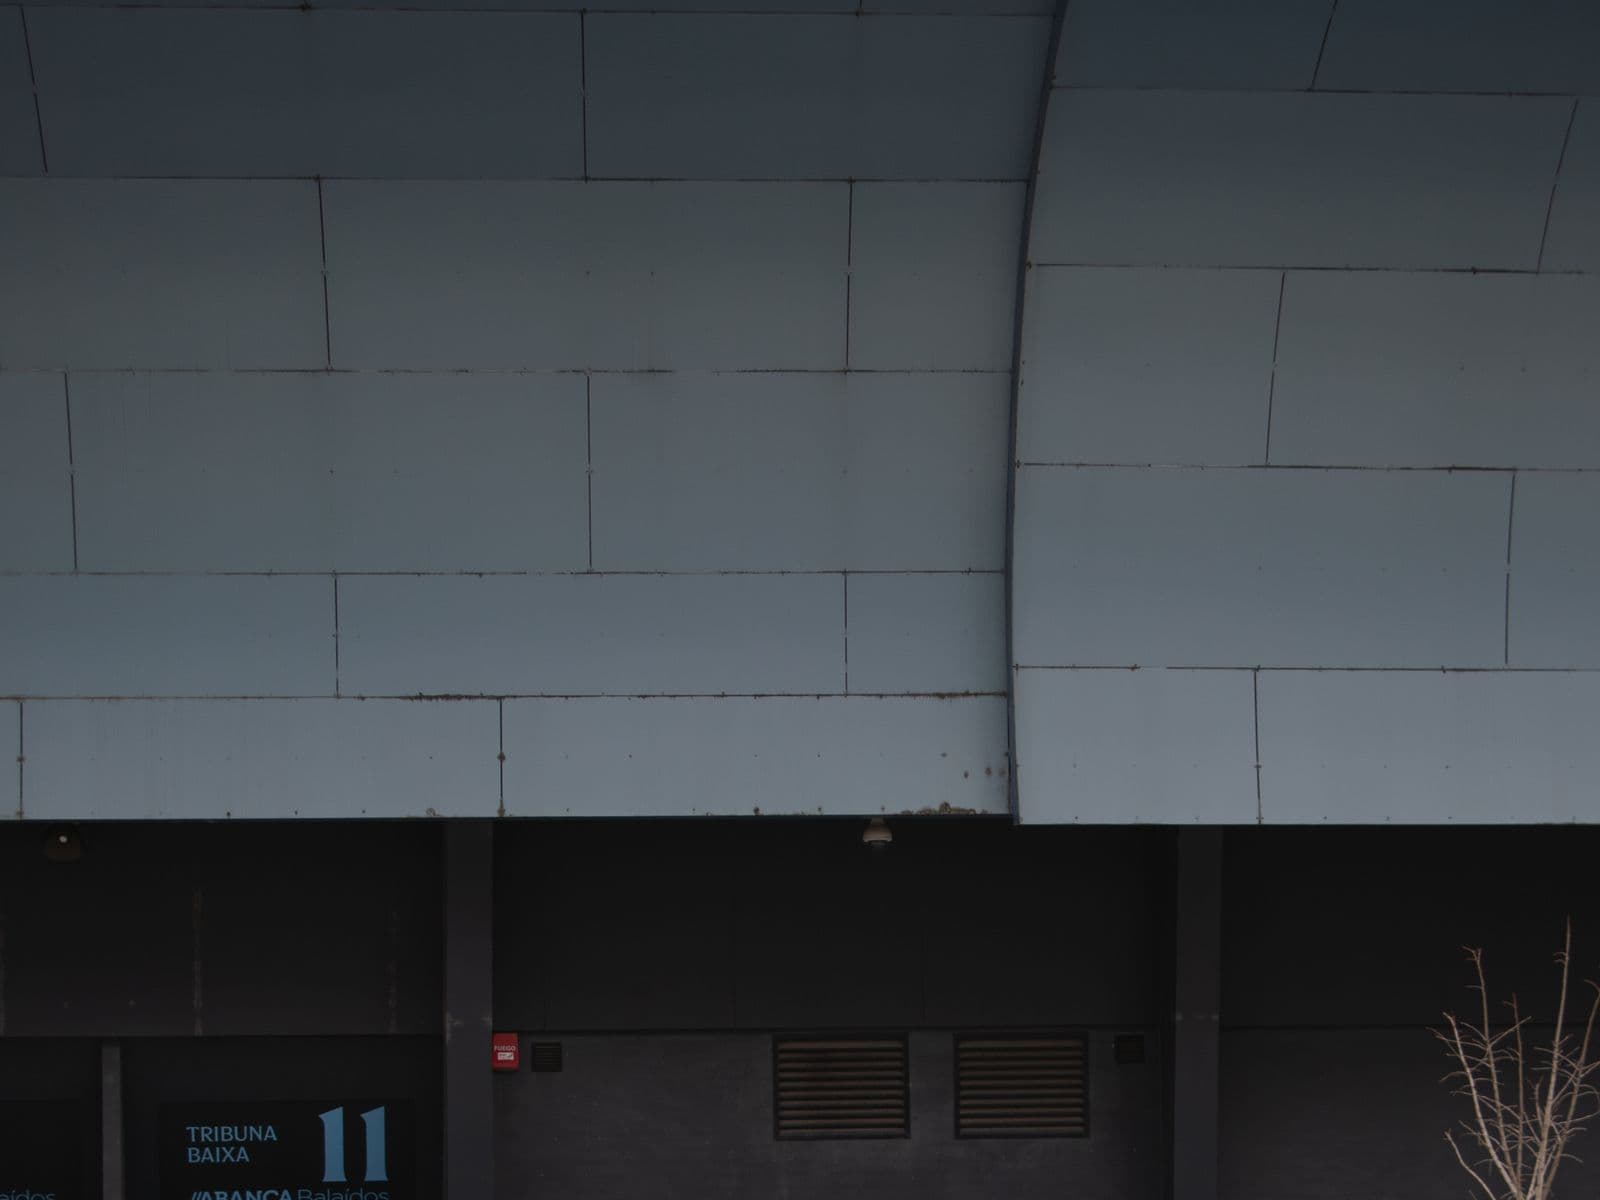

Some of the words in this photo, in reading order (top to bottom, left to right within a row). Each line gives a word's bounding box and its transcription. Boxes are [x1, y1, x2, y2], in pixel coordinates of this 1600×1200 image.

[186, 1125, 278, 1142] TRIBUNA
[318, 1105, 388, 1182] 11
[187, 1146, 250, 1163] BAIXA
